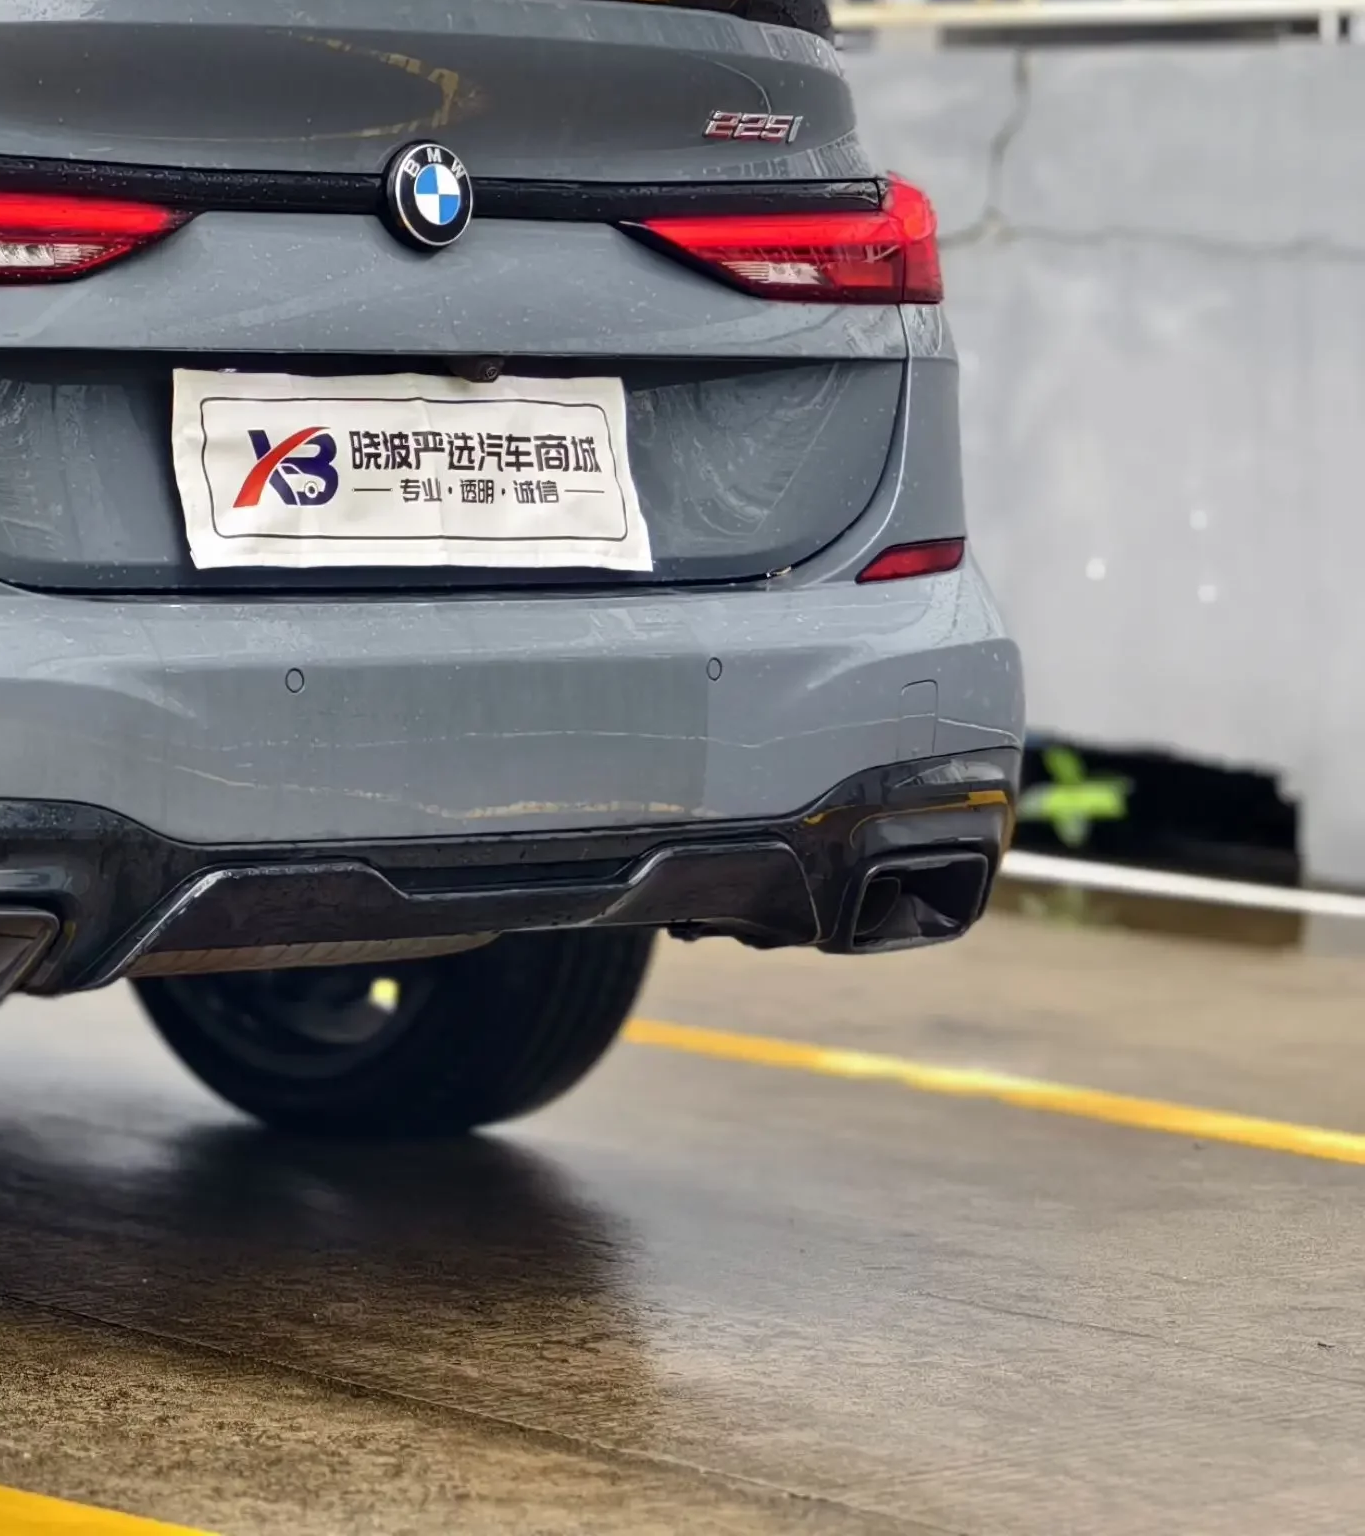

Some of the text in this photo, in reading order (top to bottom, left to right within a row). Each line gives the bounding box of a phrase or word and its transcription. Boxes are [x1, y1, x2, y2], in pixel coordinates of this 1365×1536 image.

[403, 147, 467, 180] BMW
[349, 430, 602, 474] 晓波严选汽车商城
